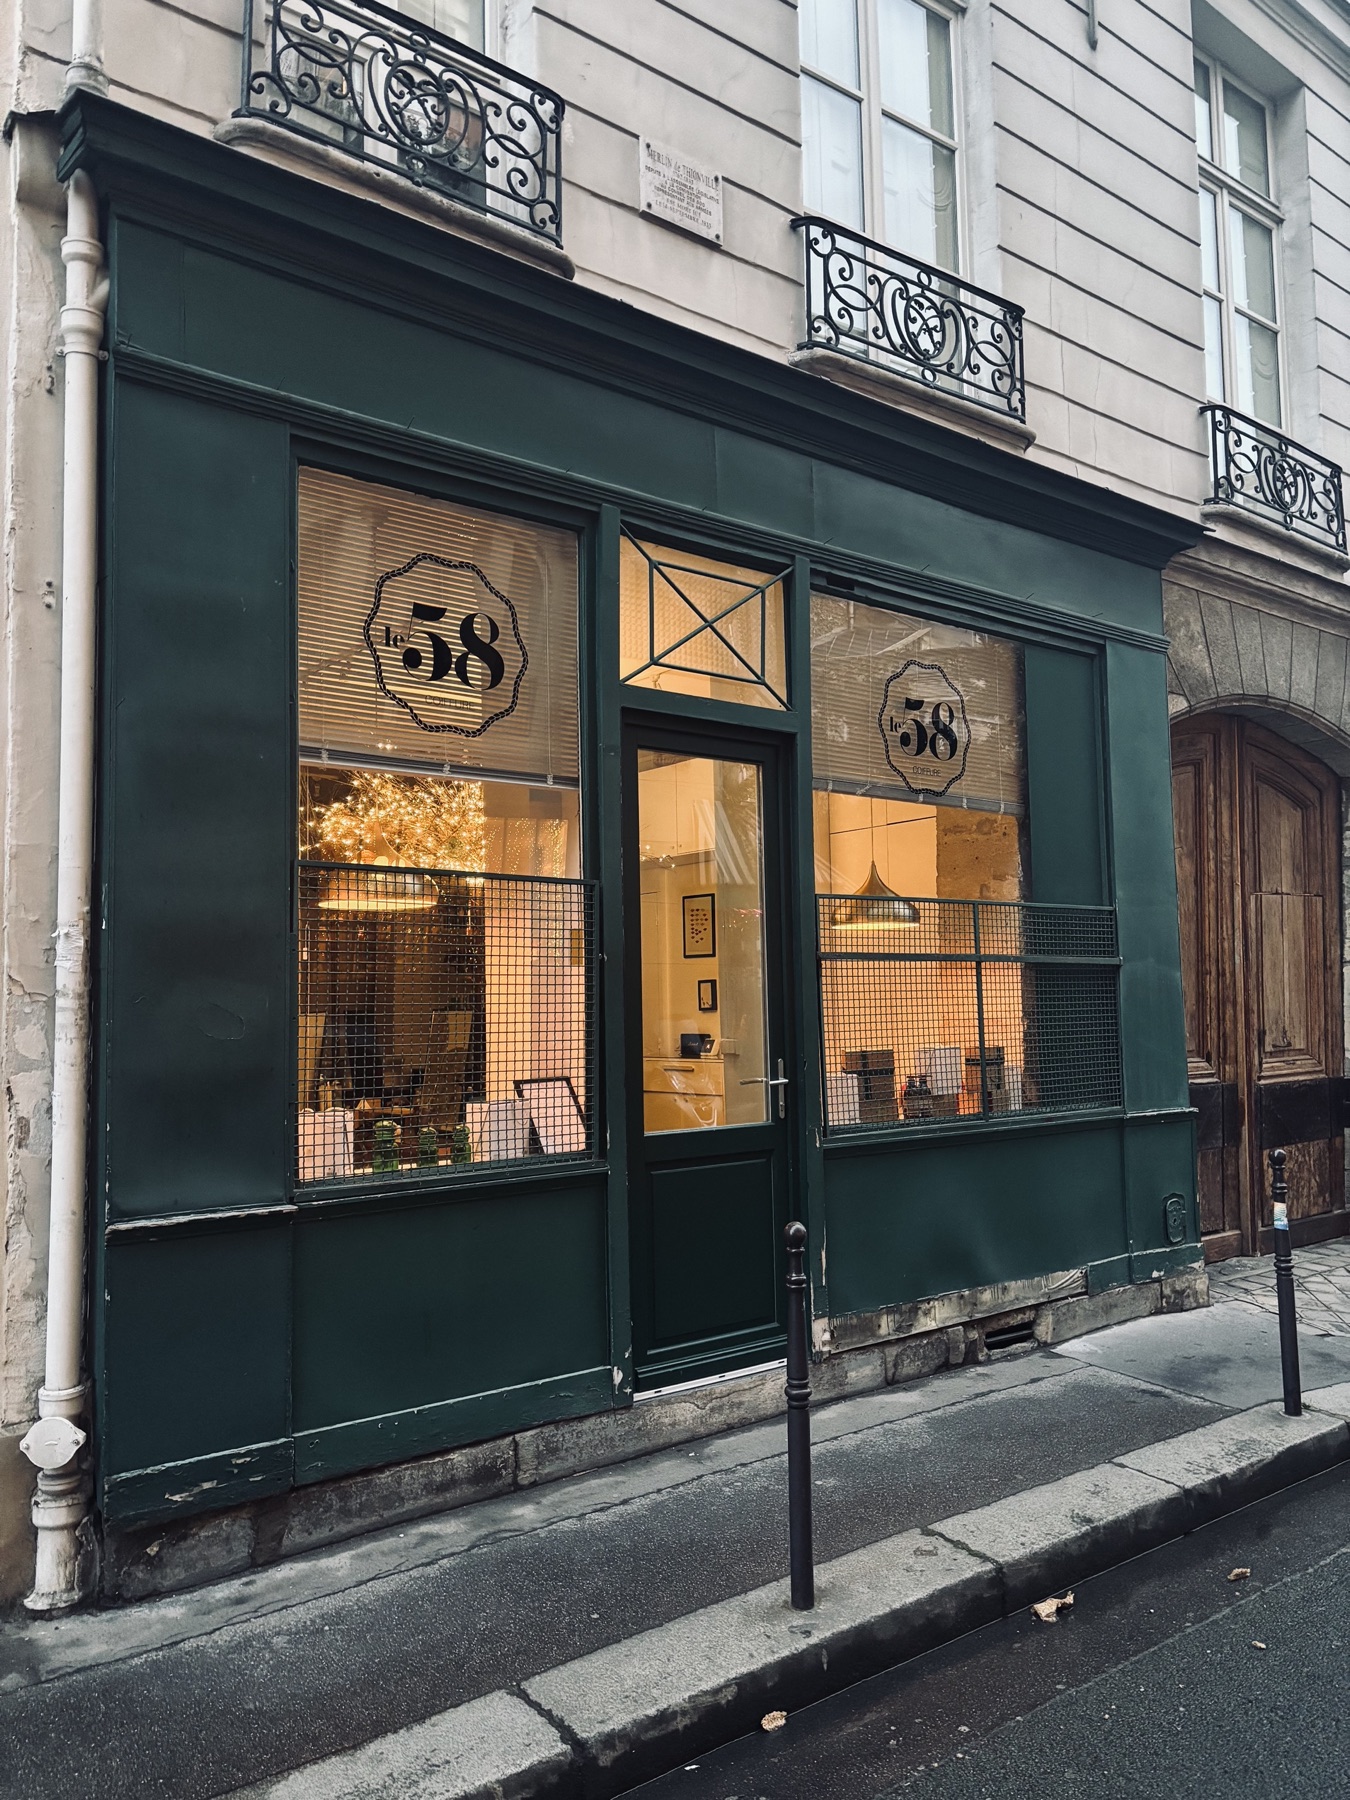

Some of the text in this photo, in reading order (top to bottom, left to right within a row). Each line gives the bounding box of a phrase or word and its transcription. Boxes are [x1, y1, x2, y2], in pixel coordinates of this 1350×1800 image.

[384, 602, 505, 691] le 58
[425, 695, 474, 711] COIFFURE
[889, 697, 958, 761] le 58
[912, 765, 942, 777] COIFFURE
